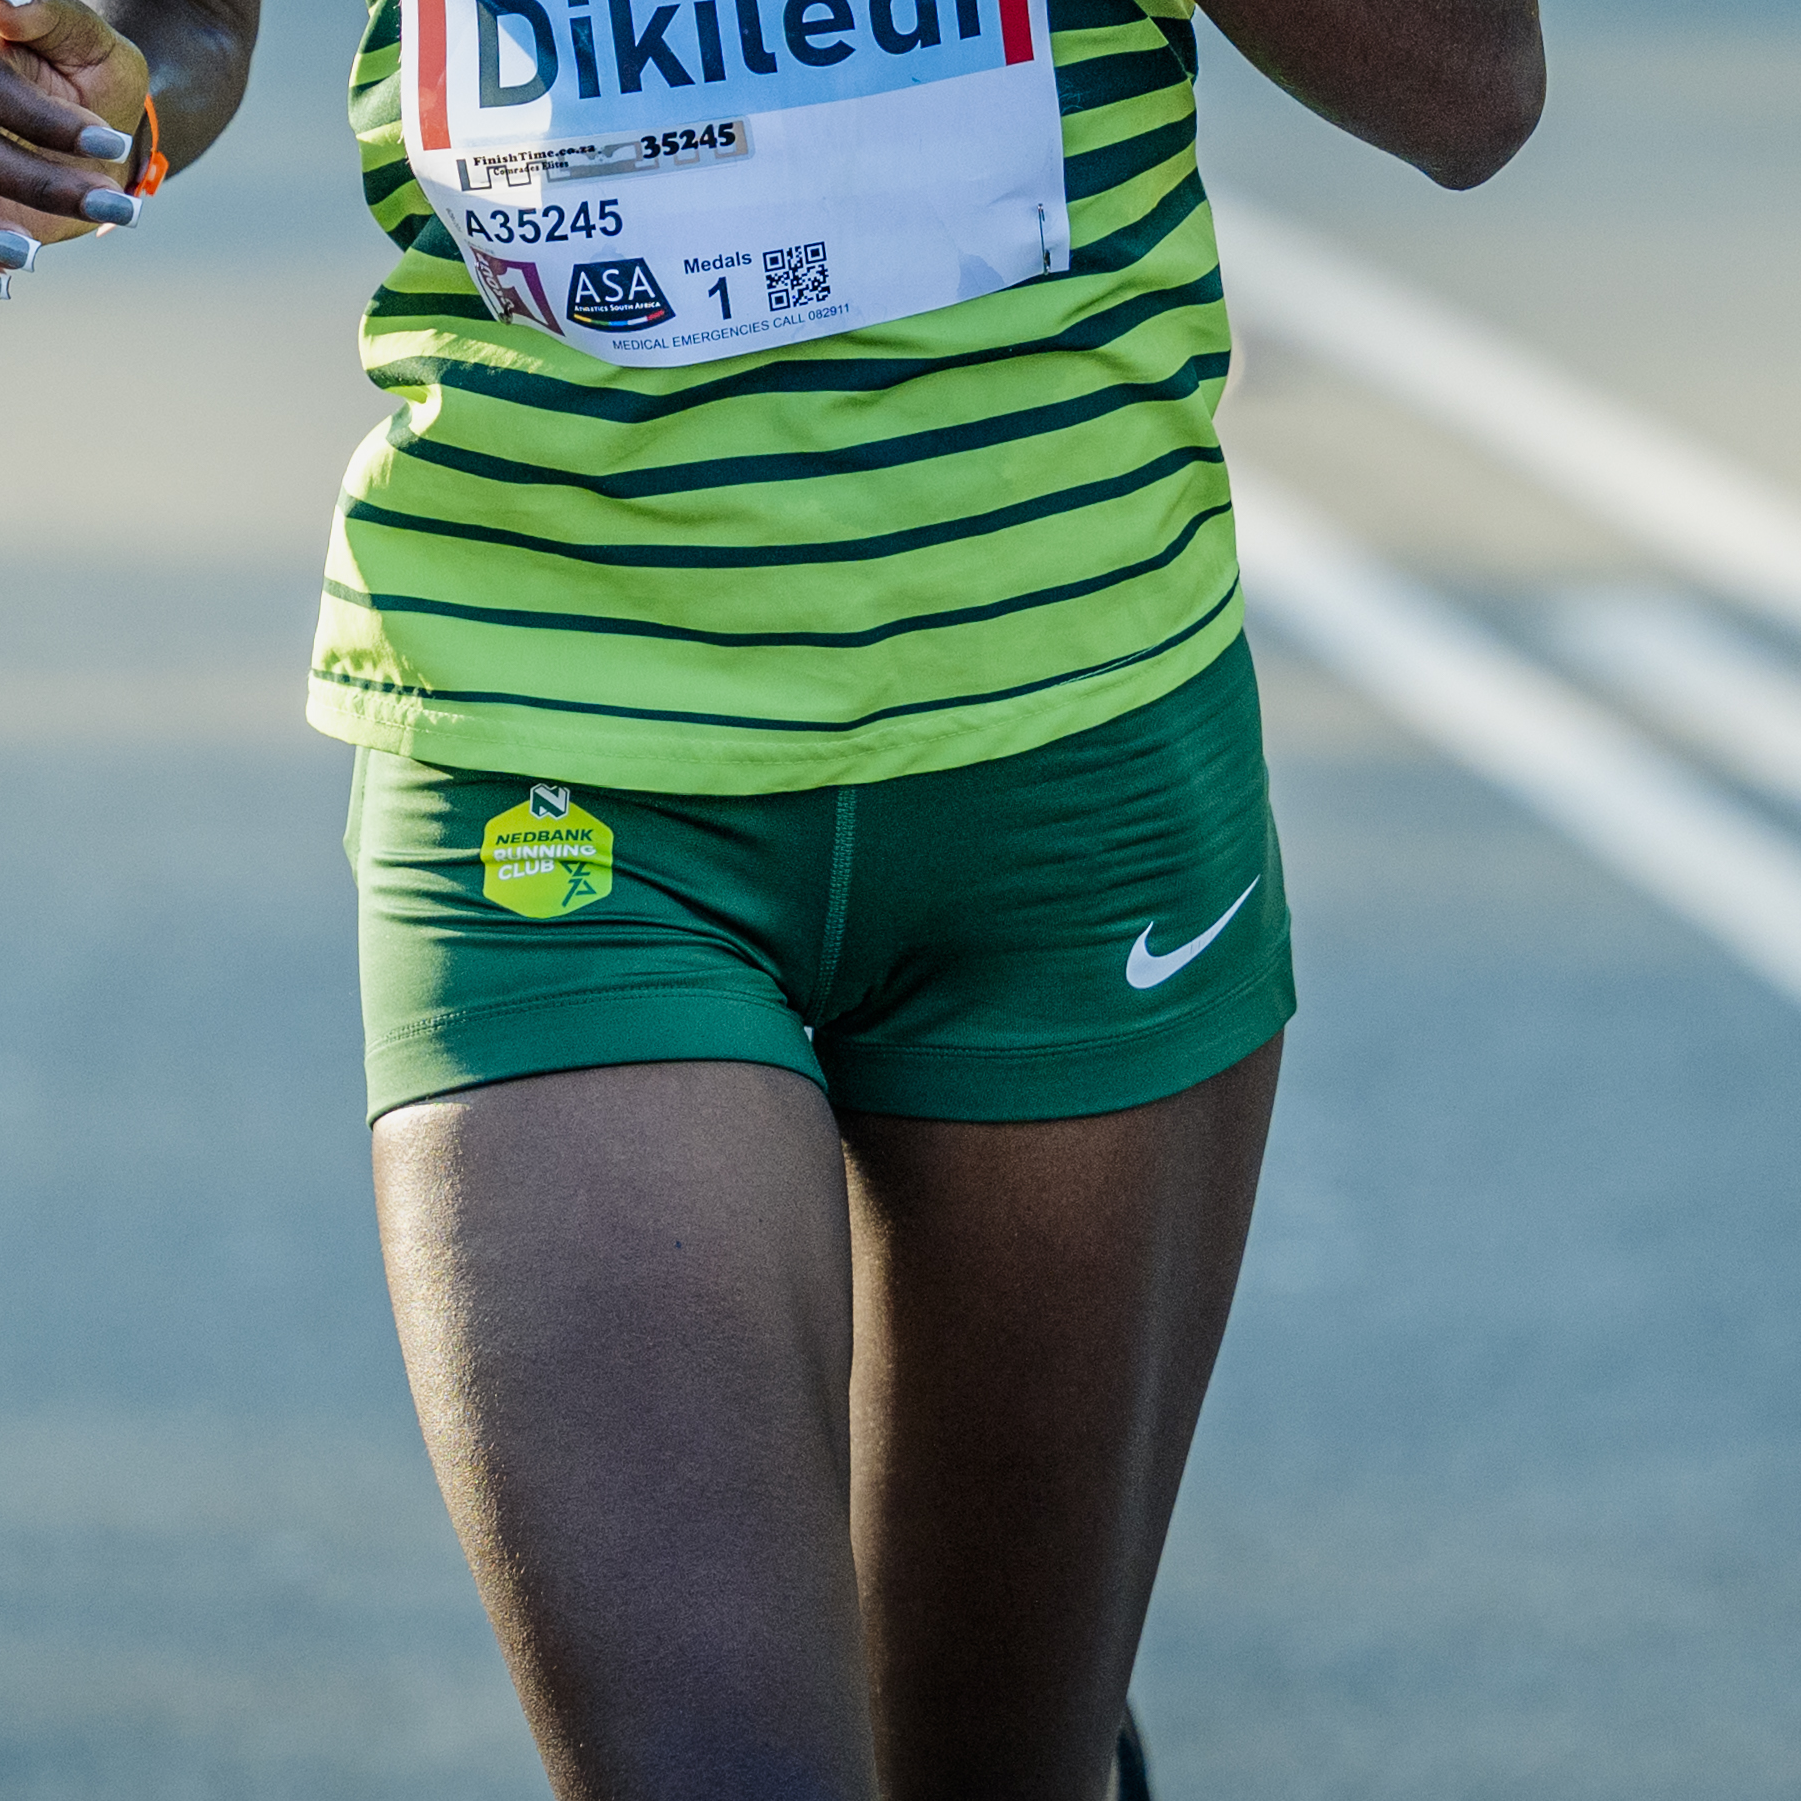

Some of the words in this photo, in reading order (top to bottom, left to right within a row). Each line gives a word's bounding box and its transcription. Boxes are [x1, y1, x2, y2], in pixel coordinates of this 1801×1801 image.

[641, 122, 736, 159] 35245
[493, 165, 539, 176] Comrades
[542, 161, 569, 171] Elites
[465, 199, 623, 245] A35245
[683, 252, 752, 274] Medals
[575, 265, 656, 304] ASA
[708, 276, 732, 321] 1
[612, 338, 670, 351] MEDICAL
[672, 320, 769, 348] EMERGENCIES
[773, 314, 805, 329] CALL
[808, 303, 849, 321] 082911
[496, 829, 594, 846] NEDBANK
[493, 845, 596, 862] RUNNING
[498, 859, 554, 881] CLUB
